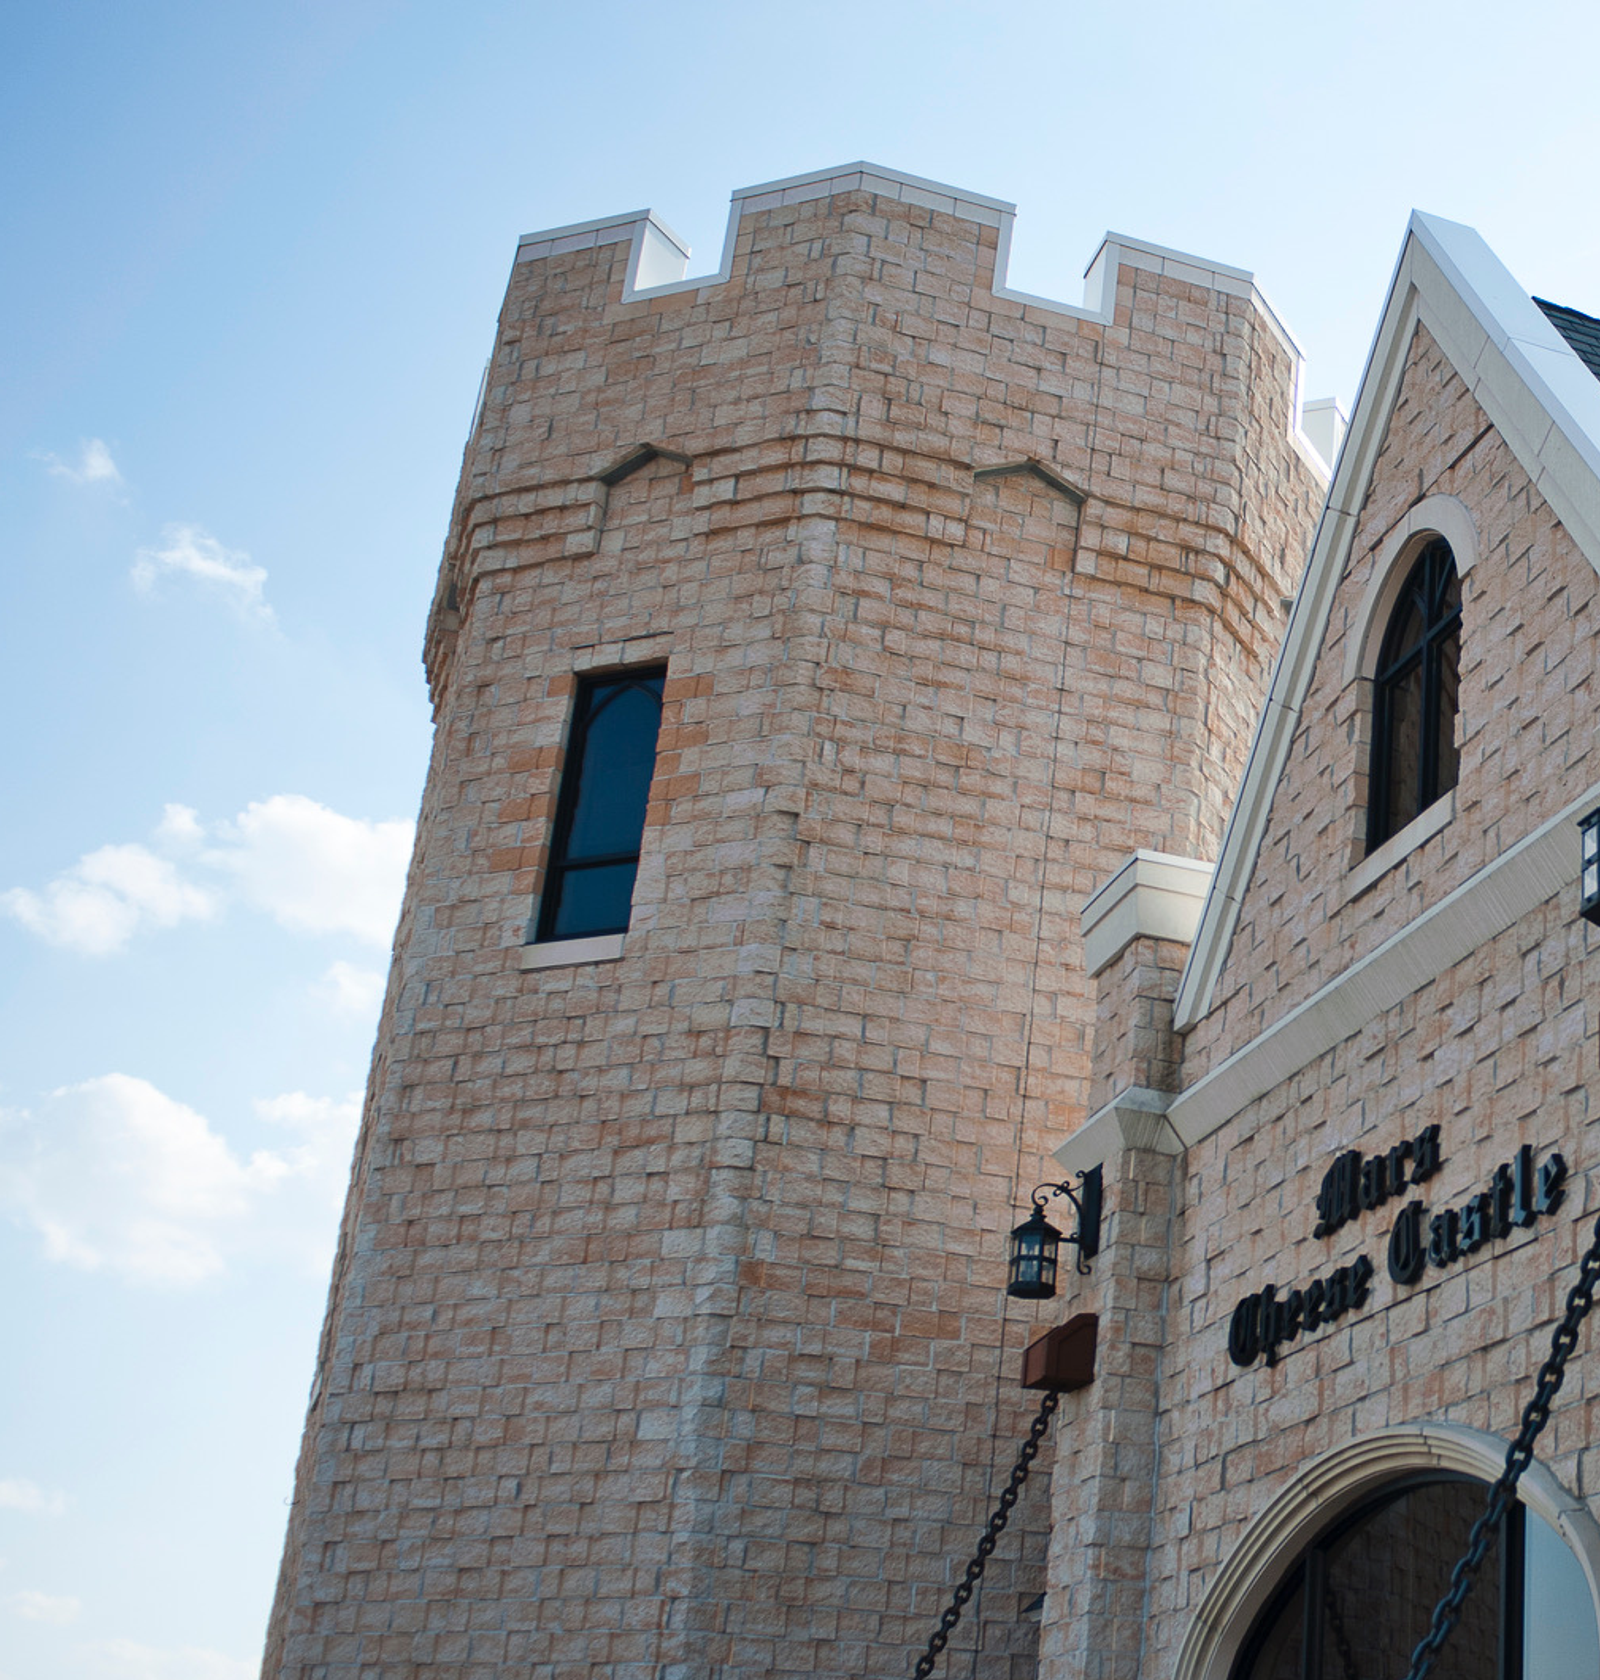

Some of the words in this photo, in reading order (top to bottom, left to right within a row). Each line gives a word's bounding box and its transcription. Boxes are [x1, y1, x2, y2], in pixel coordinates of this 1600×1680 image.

[1228, 1254, 1374, 1367] Cheese
[1388, 1144, 1568, 1285] Castle
[1313, 1124, 1441, 1239] Mars
